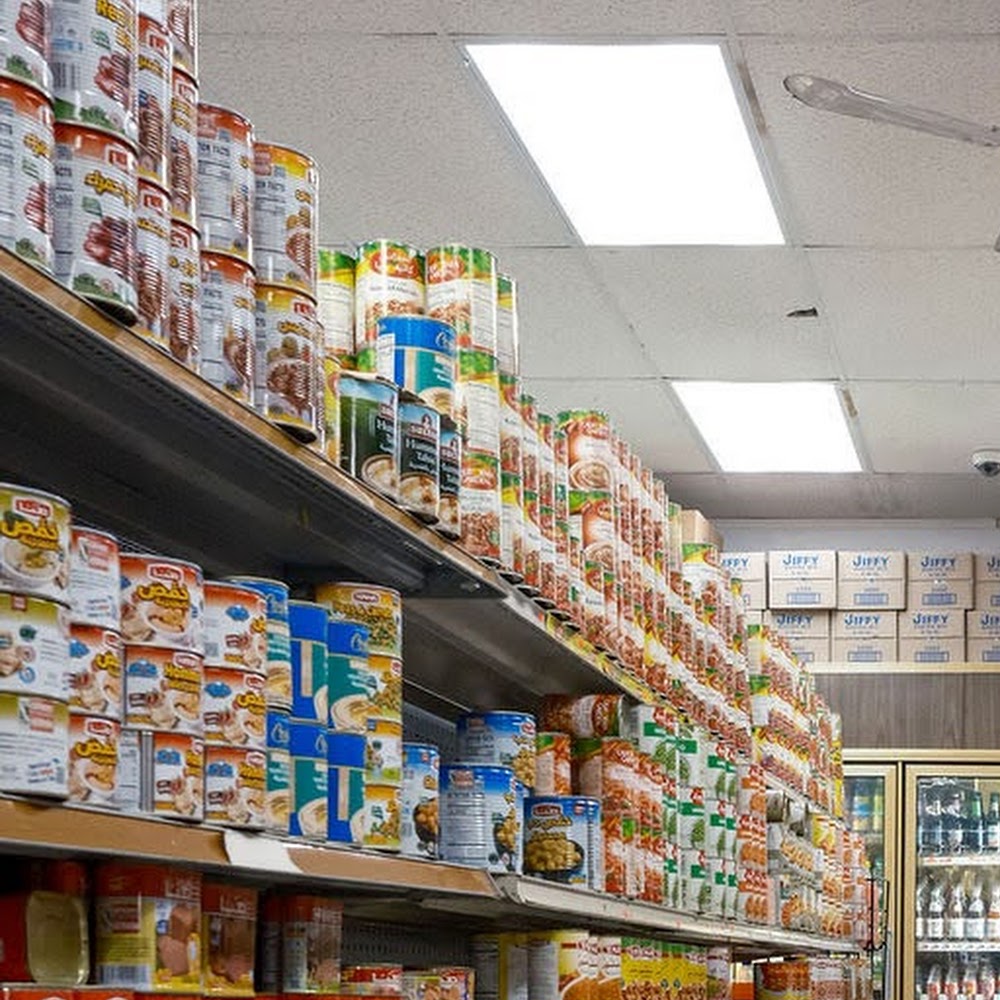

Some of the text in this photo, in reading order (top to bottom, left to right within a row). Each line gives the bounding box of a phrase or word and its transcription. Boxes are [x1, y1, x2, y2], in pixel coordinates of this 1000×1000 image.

[723, 557, 749, 567] IFFY
[783, 554, 819, 566] JIFFY
[853, 555, 889, 567] JIFFY
[921, 556, 955, 567] JIFFY
[777, 613, 813, 626] JIFFY
[844, 613, 881, 626] JIFFY
[912, 613, 948, 625] JIFFY
